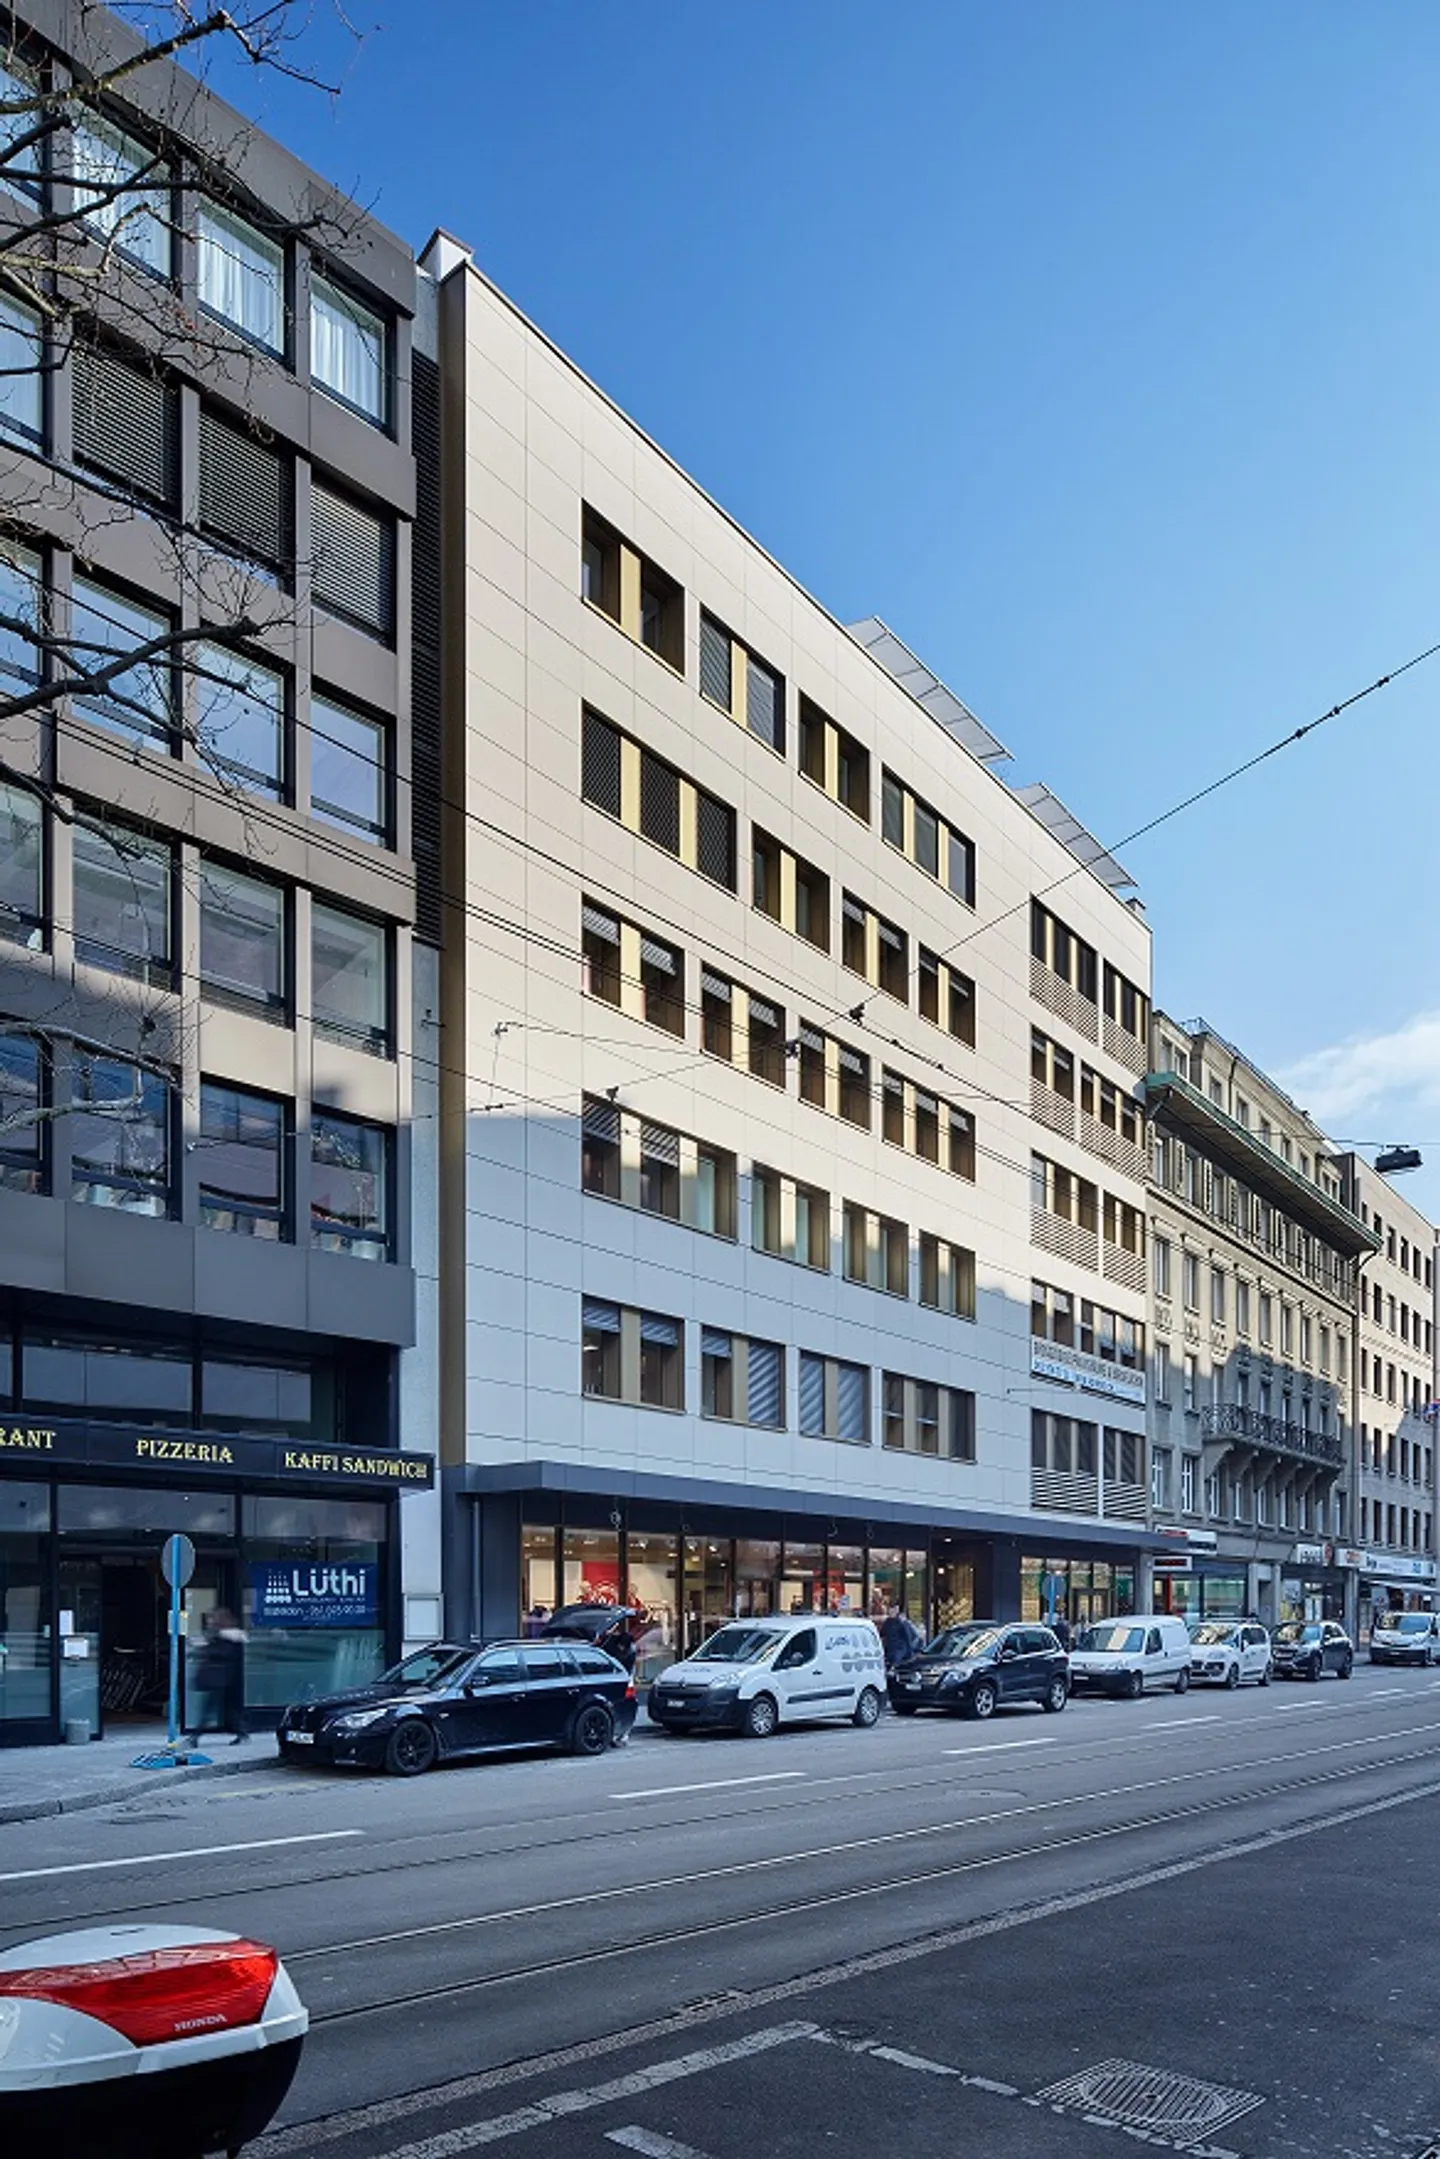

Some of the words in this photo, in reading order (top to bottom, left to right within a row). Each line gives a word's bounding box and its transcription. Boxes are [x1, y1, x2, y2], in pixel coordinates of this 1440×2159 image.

[136, 1438, 234, 1464] PIZZERIA
[285, 1452, 339, 1471] KAFFI
[342, 1457, 427, 1478] SANDWICH
[292, 1568, 366, 1596] Lüthi
[174, 2013, 228, 2032] HONDA
